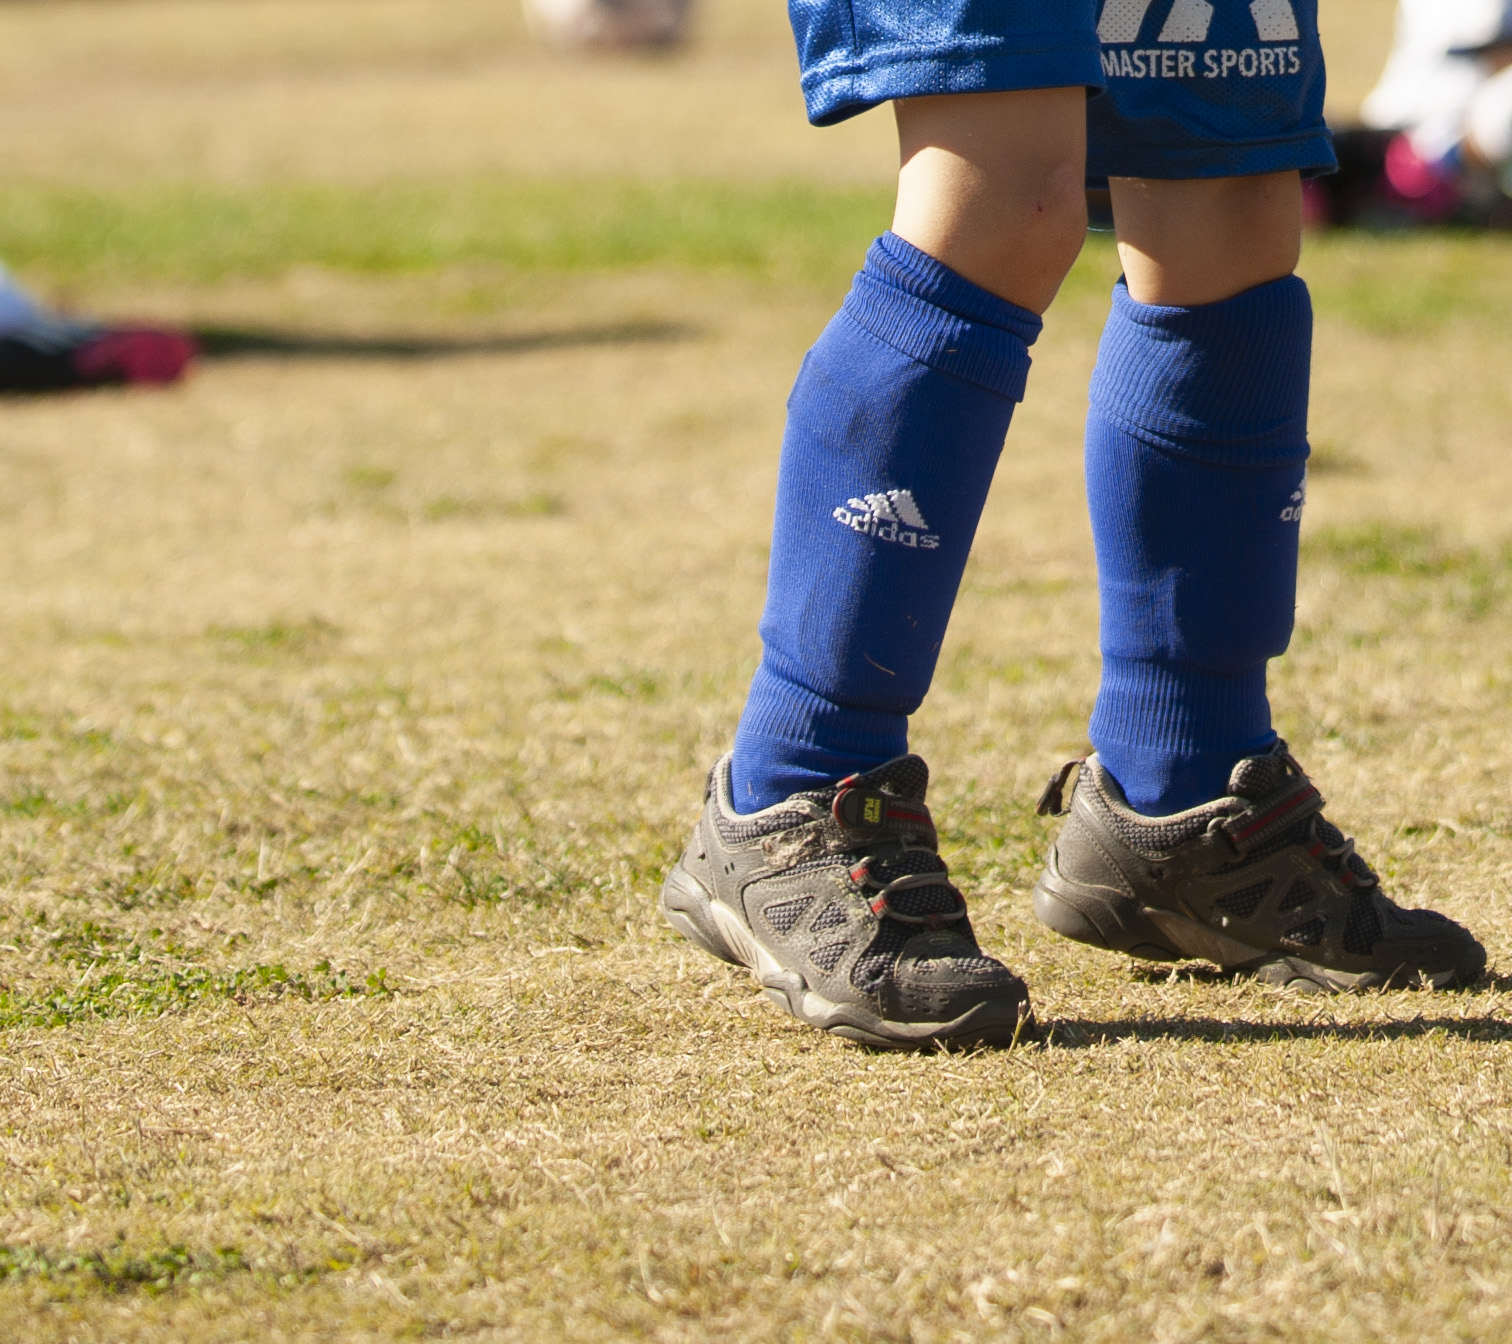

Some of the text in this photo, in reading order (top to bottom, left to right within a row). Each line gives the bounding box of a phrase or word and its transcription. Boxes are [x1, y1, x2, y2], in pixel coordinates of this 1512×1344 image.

[1100, 46, 1301, 79] MASTER SPORTS
[832, 506, 940, 549] adidas
